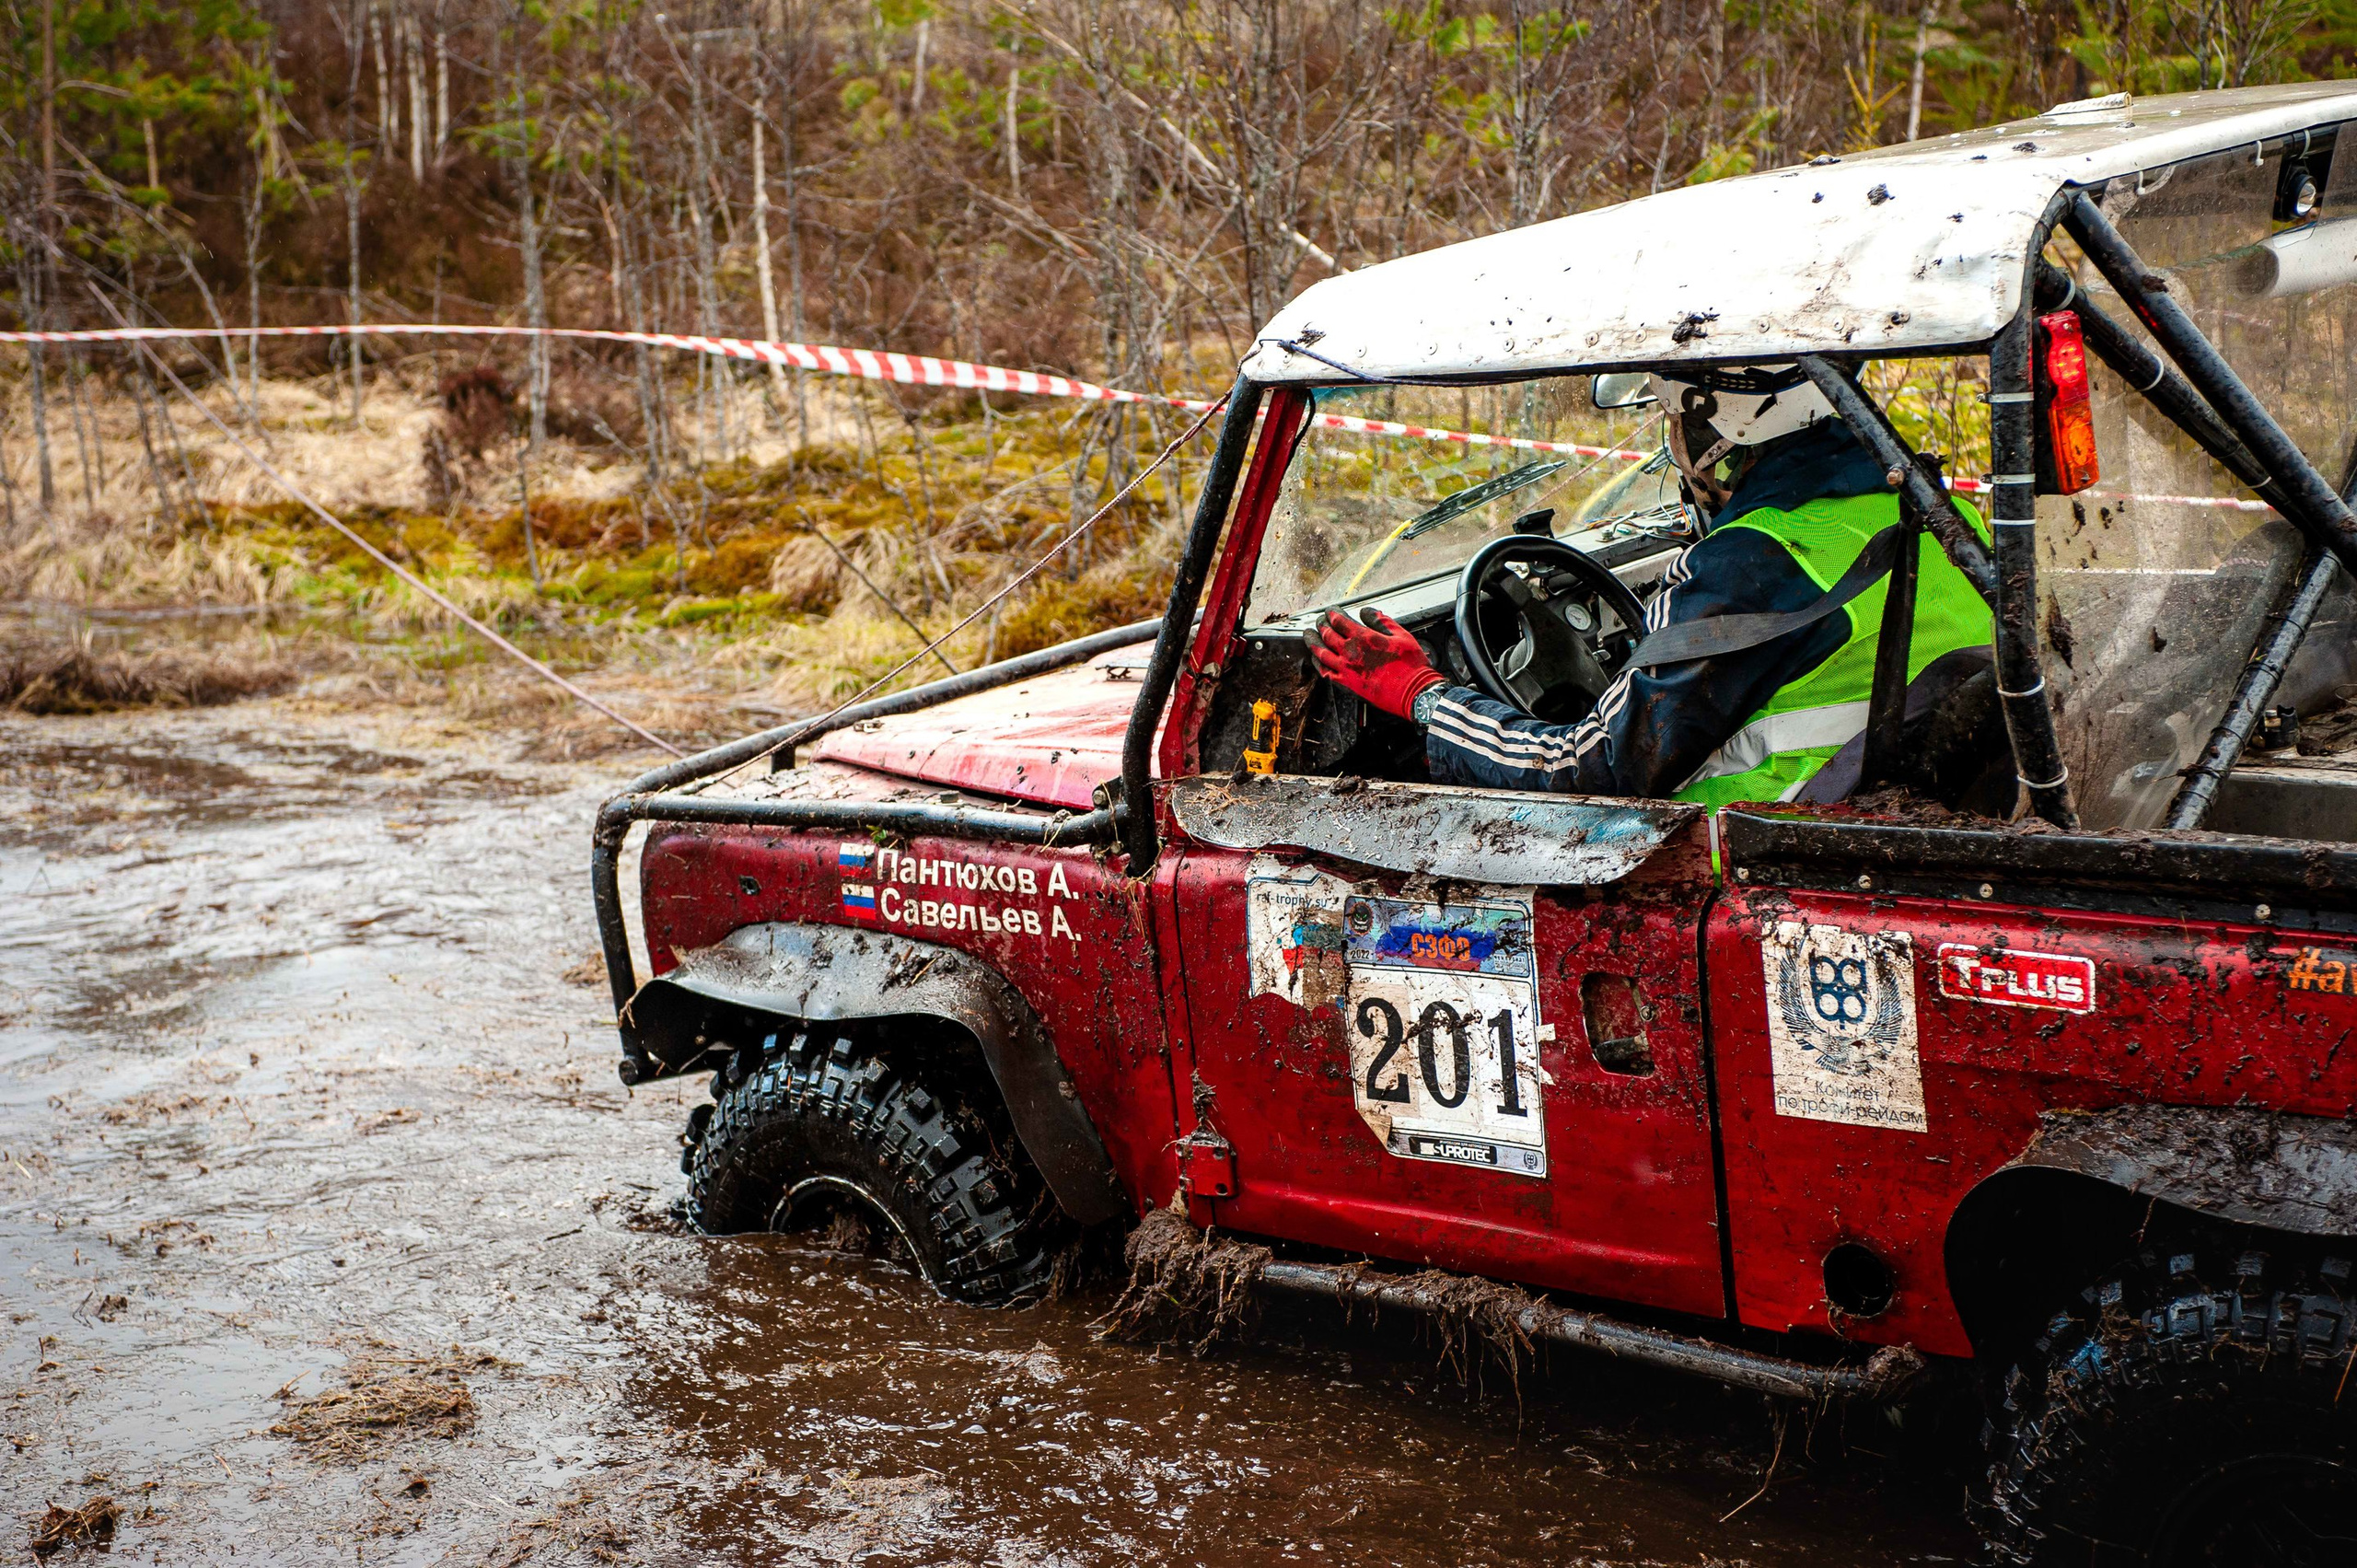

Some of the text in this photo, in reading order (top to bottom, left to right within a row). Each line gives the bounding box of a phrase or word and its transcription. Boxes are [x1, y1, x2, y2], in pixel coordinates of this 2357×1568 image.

[877, 848, 1080, 900] Пантюхов А.
[879, 888, 1083, 942] Савельев А.
[1351, 949, 1370, 959] 2022
[1356, 997, 1528, 1118] 201
[1778, 1095, 1798, 1109] по
